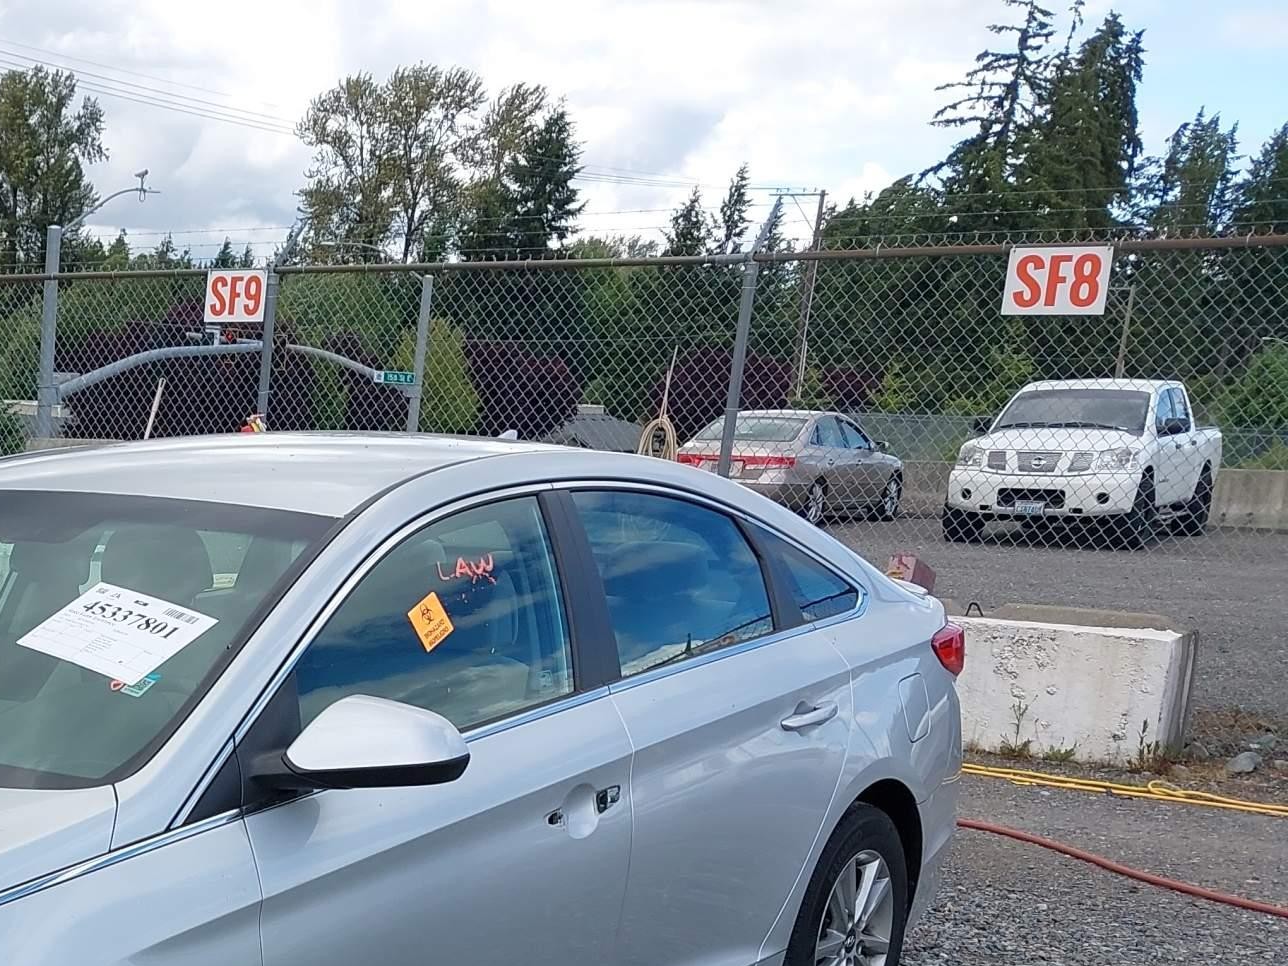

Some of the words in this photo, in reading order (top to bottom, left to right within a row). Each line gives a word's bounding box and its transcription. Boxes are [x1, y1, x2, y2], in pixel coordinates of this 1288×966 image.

[210, 275, 262, 317] SF9
[1011, 252, 1103, 309] SF8
[437, 554, 495, 581] LAW
[82, 600, 180, 639] 45337801
